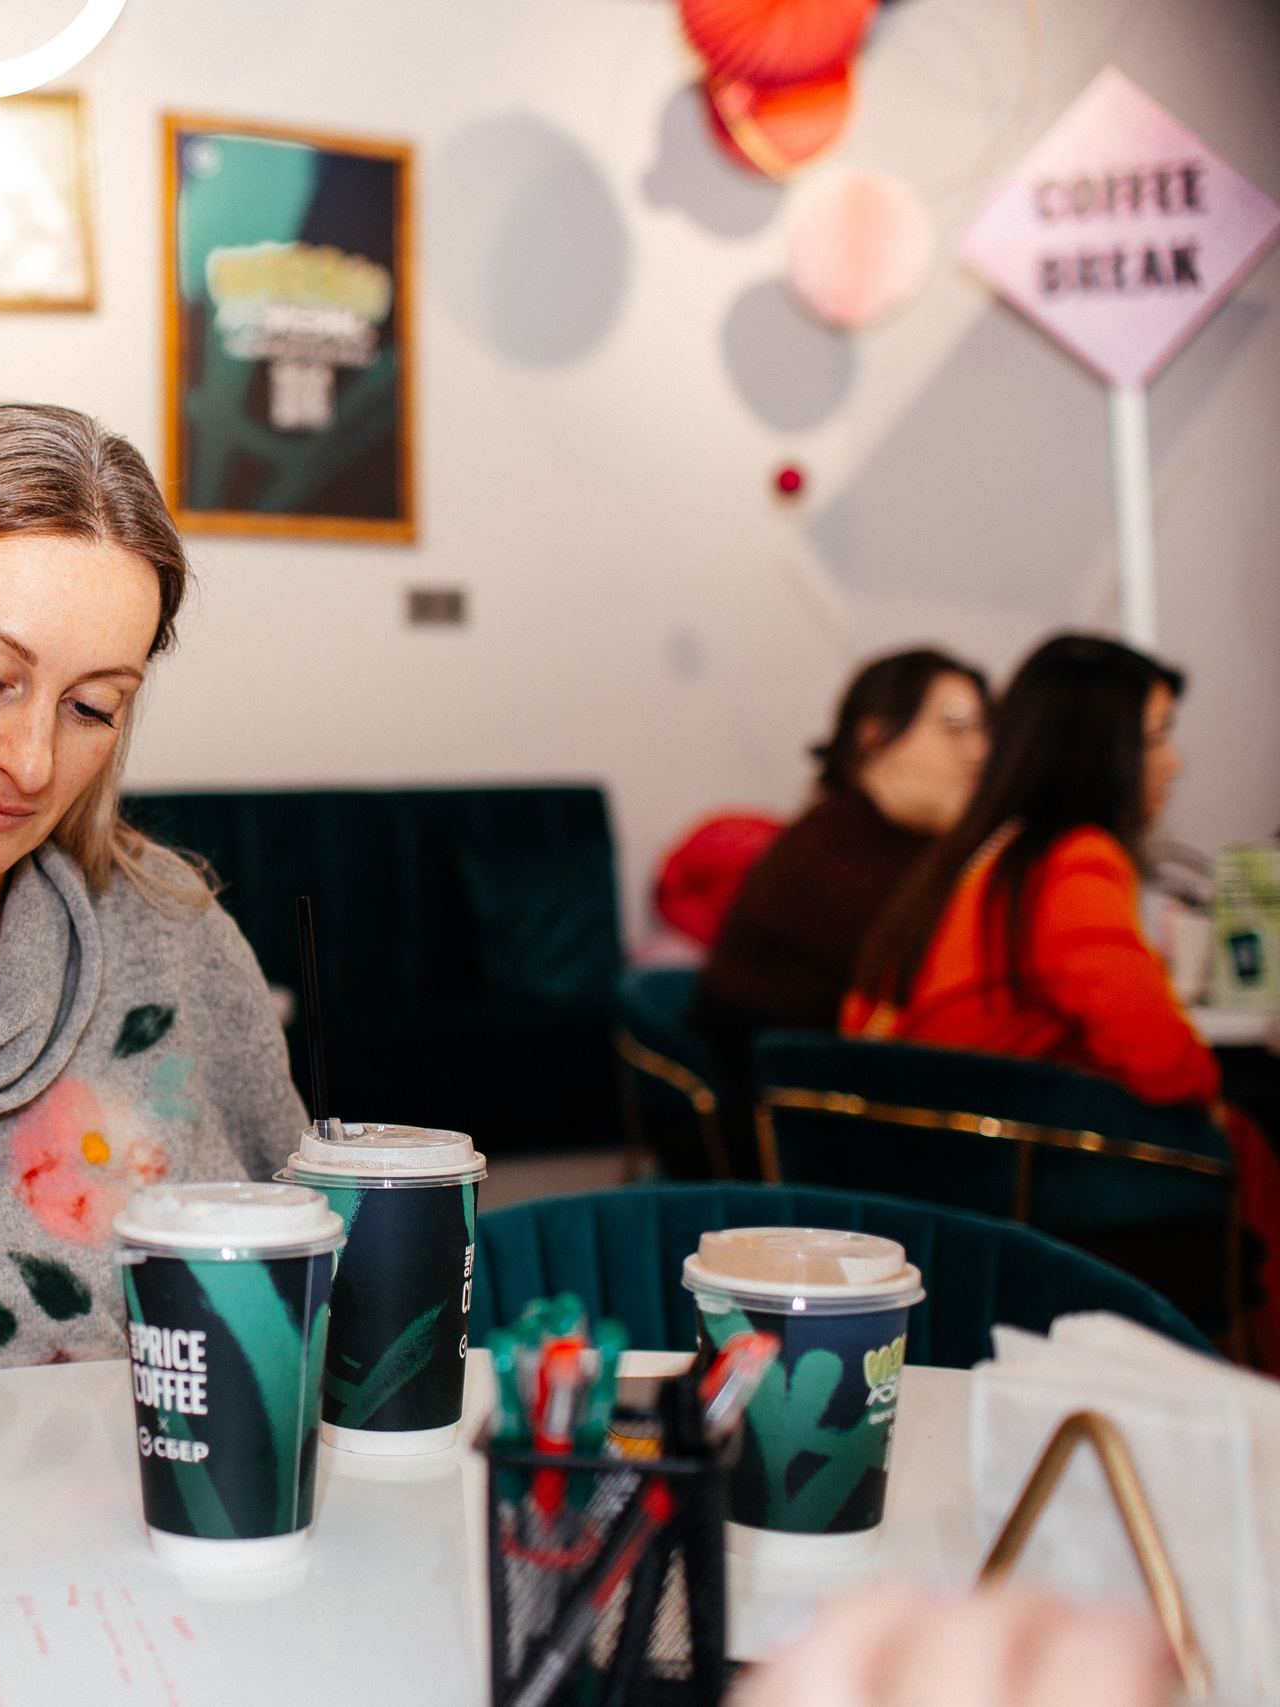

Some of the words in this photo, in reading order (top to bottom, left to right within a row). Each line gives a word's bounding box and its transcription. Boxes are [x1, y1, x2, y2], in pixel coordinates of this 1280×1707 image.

[1035, 162, 1204, 221] COFFEE
[1038, 243, 1199, 295] BREAK
[132, 1361, 209, 1416] COFFEE
[153, 1435, 210, 1463] СБЕР
